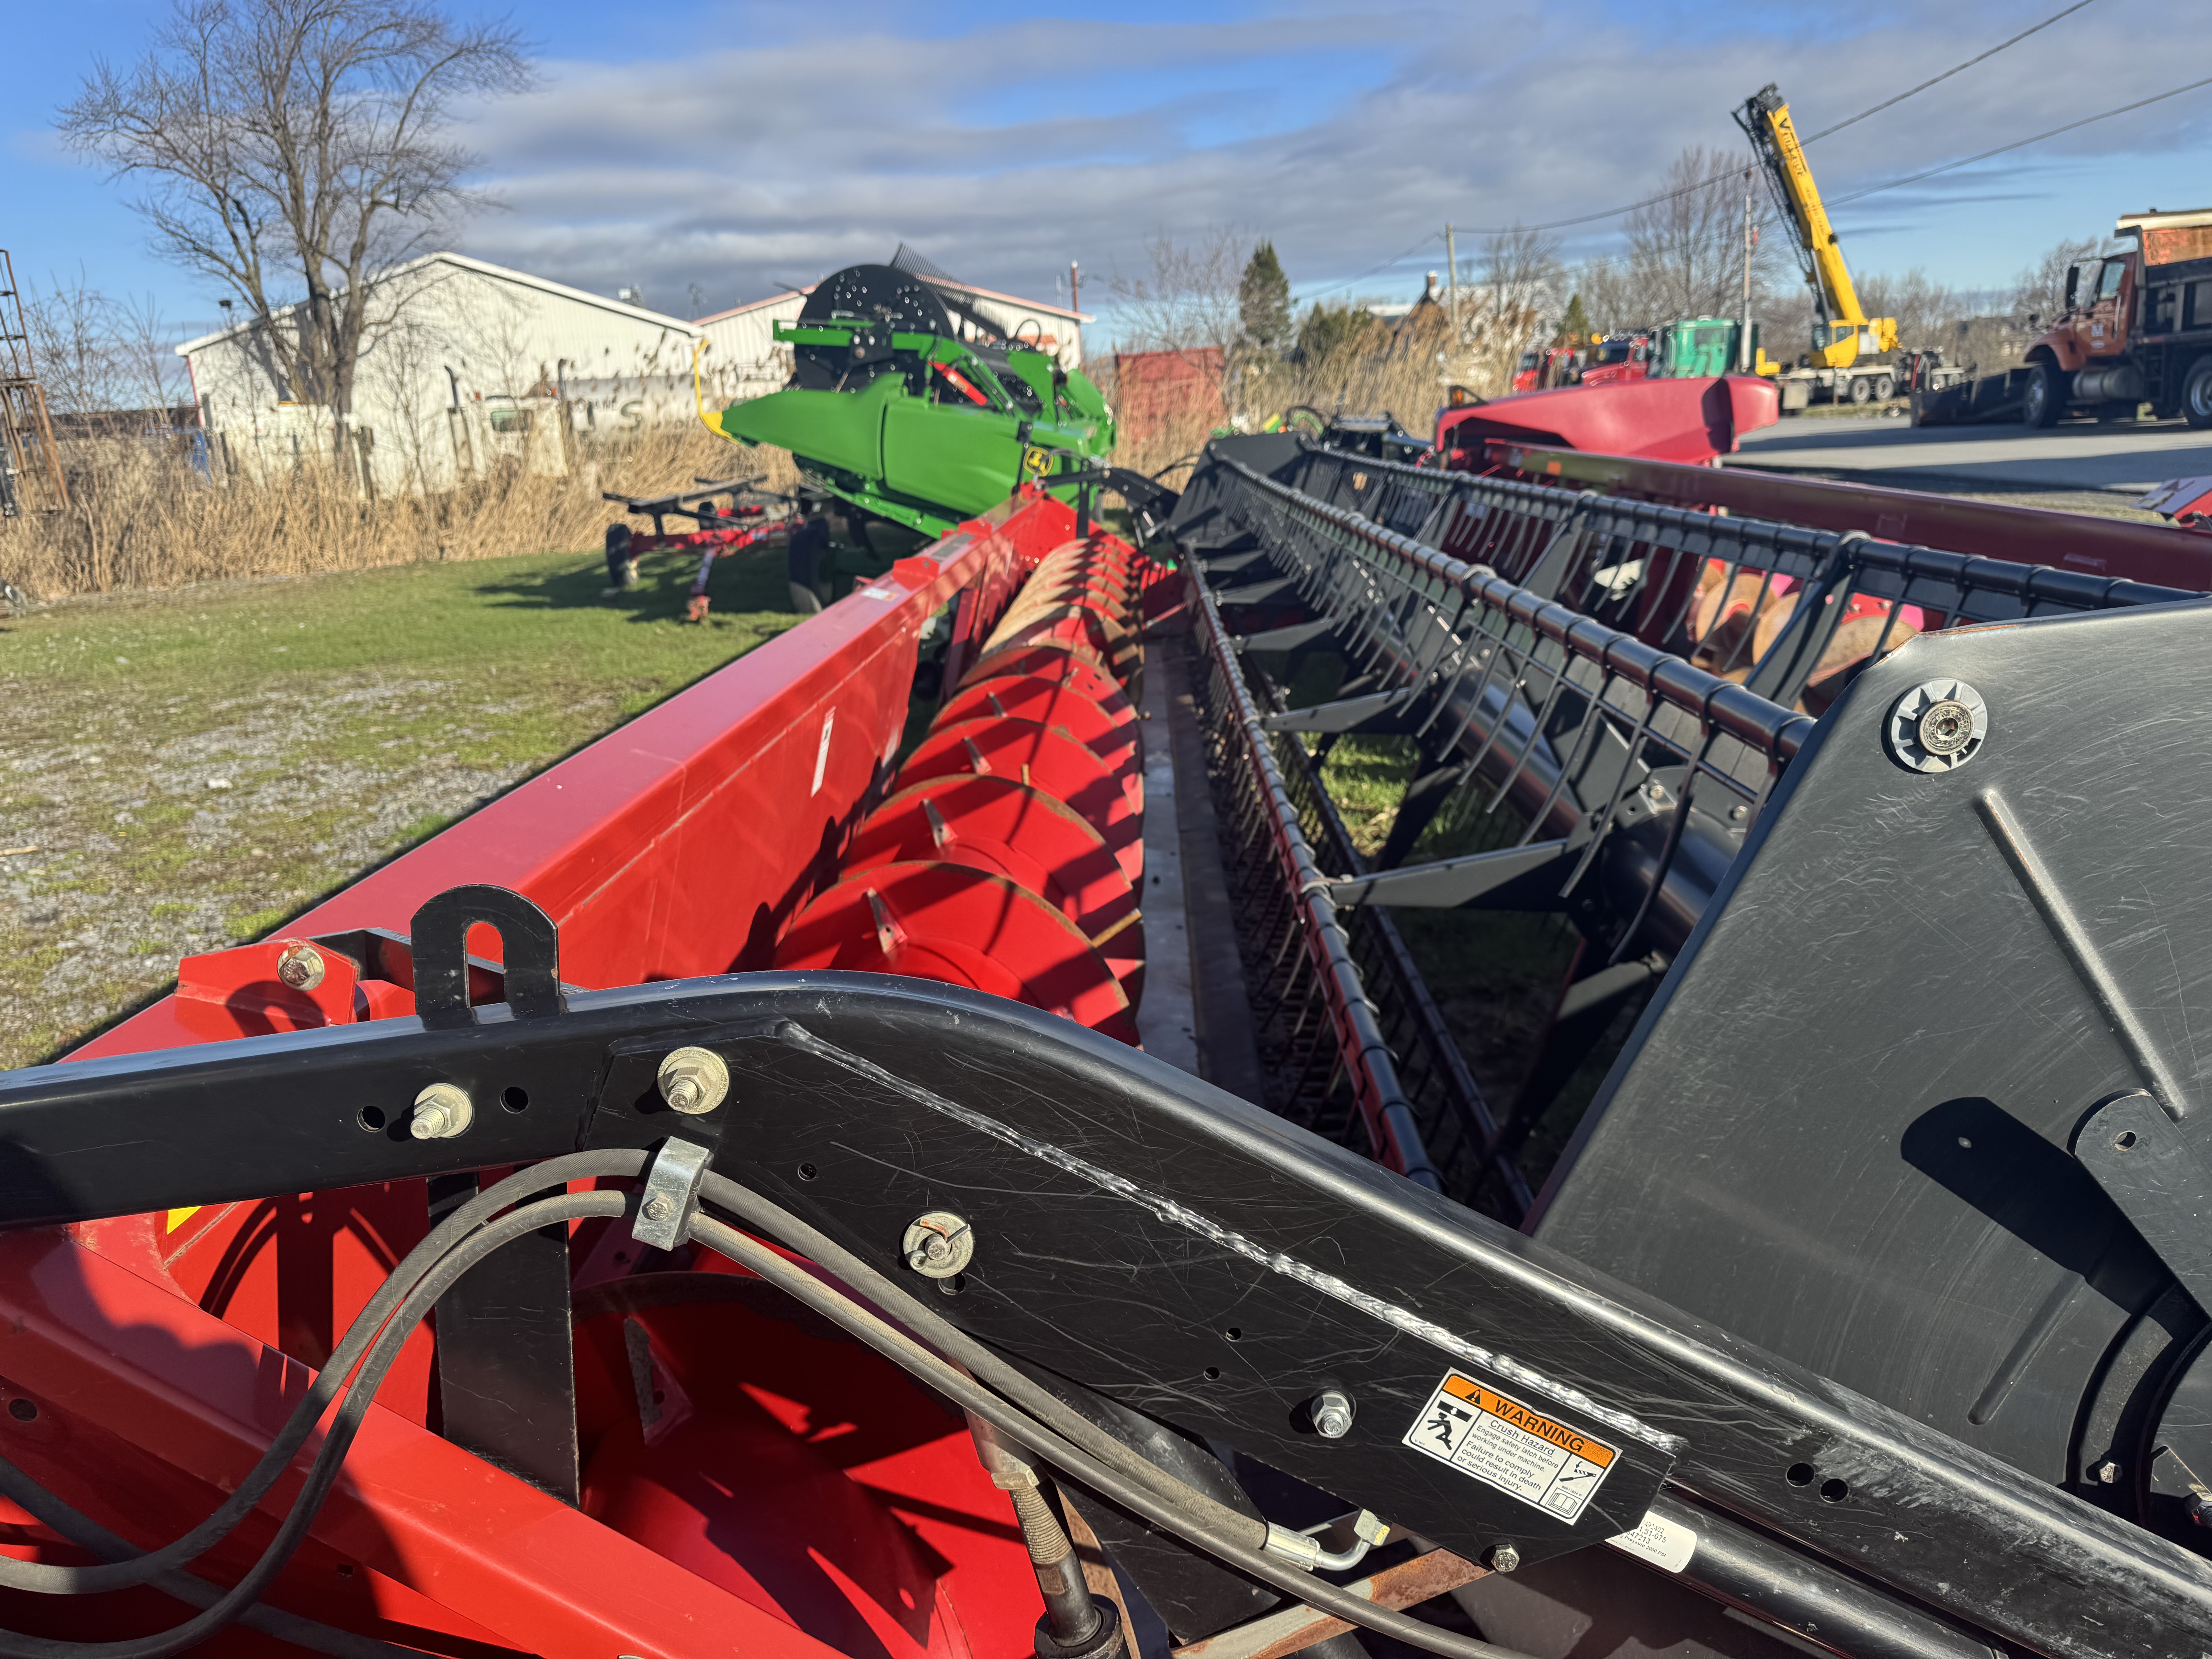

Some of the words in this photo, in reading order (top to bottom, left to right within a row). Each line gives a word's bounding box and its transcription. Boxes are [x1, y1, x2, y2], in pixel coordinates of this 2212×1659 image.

[1490, 1420, 1519, 1439] Crush
[1522, 1434, 1556, 1456] Hazard
[1495, 1400, 1585, 1453] WARNING
[1466, 1441, 1495, 1458] Failure
[1505, 1460, 1535, 1478] comply
[1472, 1433, 1497, 1449] working
[1498, 1446, 1518, 1458] under
[1518, 1455, 1545, 1472] machine.
[1476, 1425, 1501, 1441] Engage
[1501, 1437, 1521, 1451] safety
[1522, 1447, 1537, 1458] latch
[1538, 1455, 1559, 1469] before
[1462, 1449, 1486, 1463] could
[1486, 1460, 1509, 1474] result
[1509, 1470, 1518, 1479] in
[1518, 1475, 1542, 1491] death
[1470, 1462, 1497, 1477] serious
[1499, 1474, 1522, 1491] injury.
